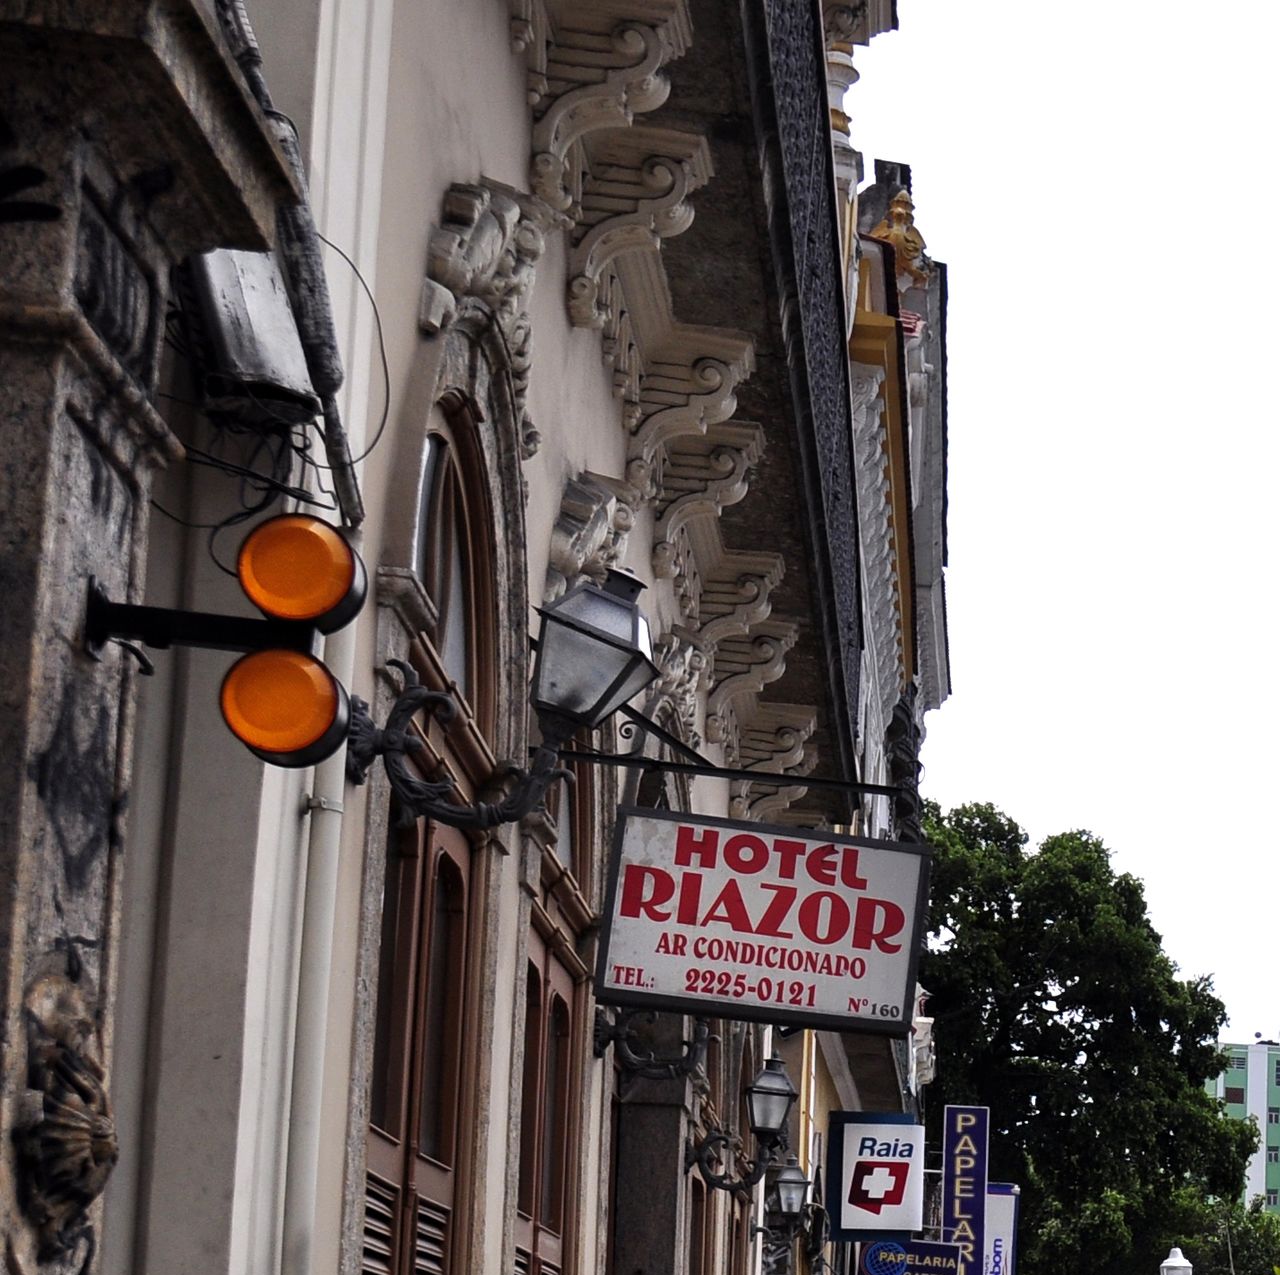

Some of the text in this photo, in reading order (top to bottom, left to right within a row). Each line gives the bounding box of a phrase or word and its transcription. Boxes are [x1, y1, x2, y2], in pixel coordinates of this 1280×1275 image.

[674, 825, 868, 891] HOTEL
[619, 863, 906, 955] RIAZOR
[654, 932, 867, 980] AR CONDICIONADO
[612, 965, 655, 989] TEL.:
[685, 967, 817, 1007] 2225-0121
[857, 1136, 914, 1159] Raia
[879, 1251, 956, 1269] PAPELARIA
